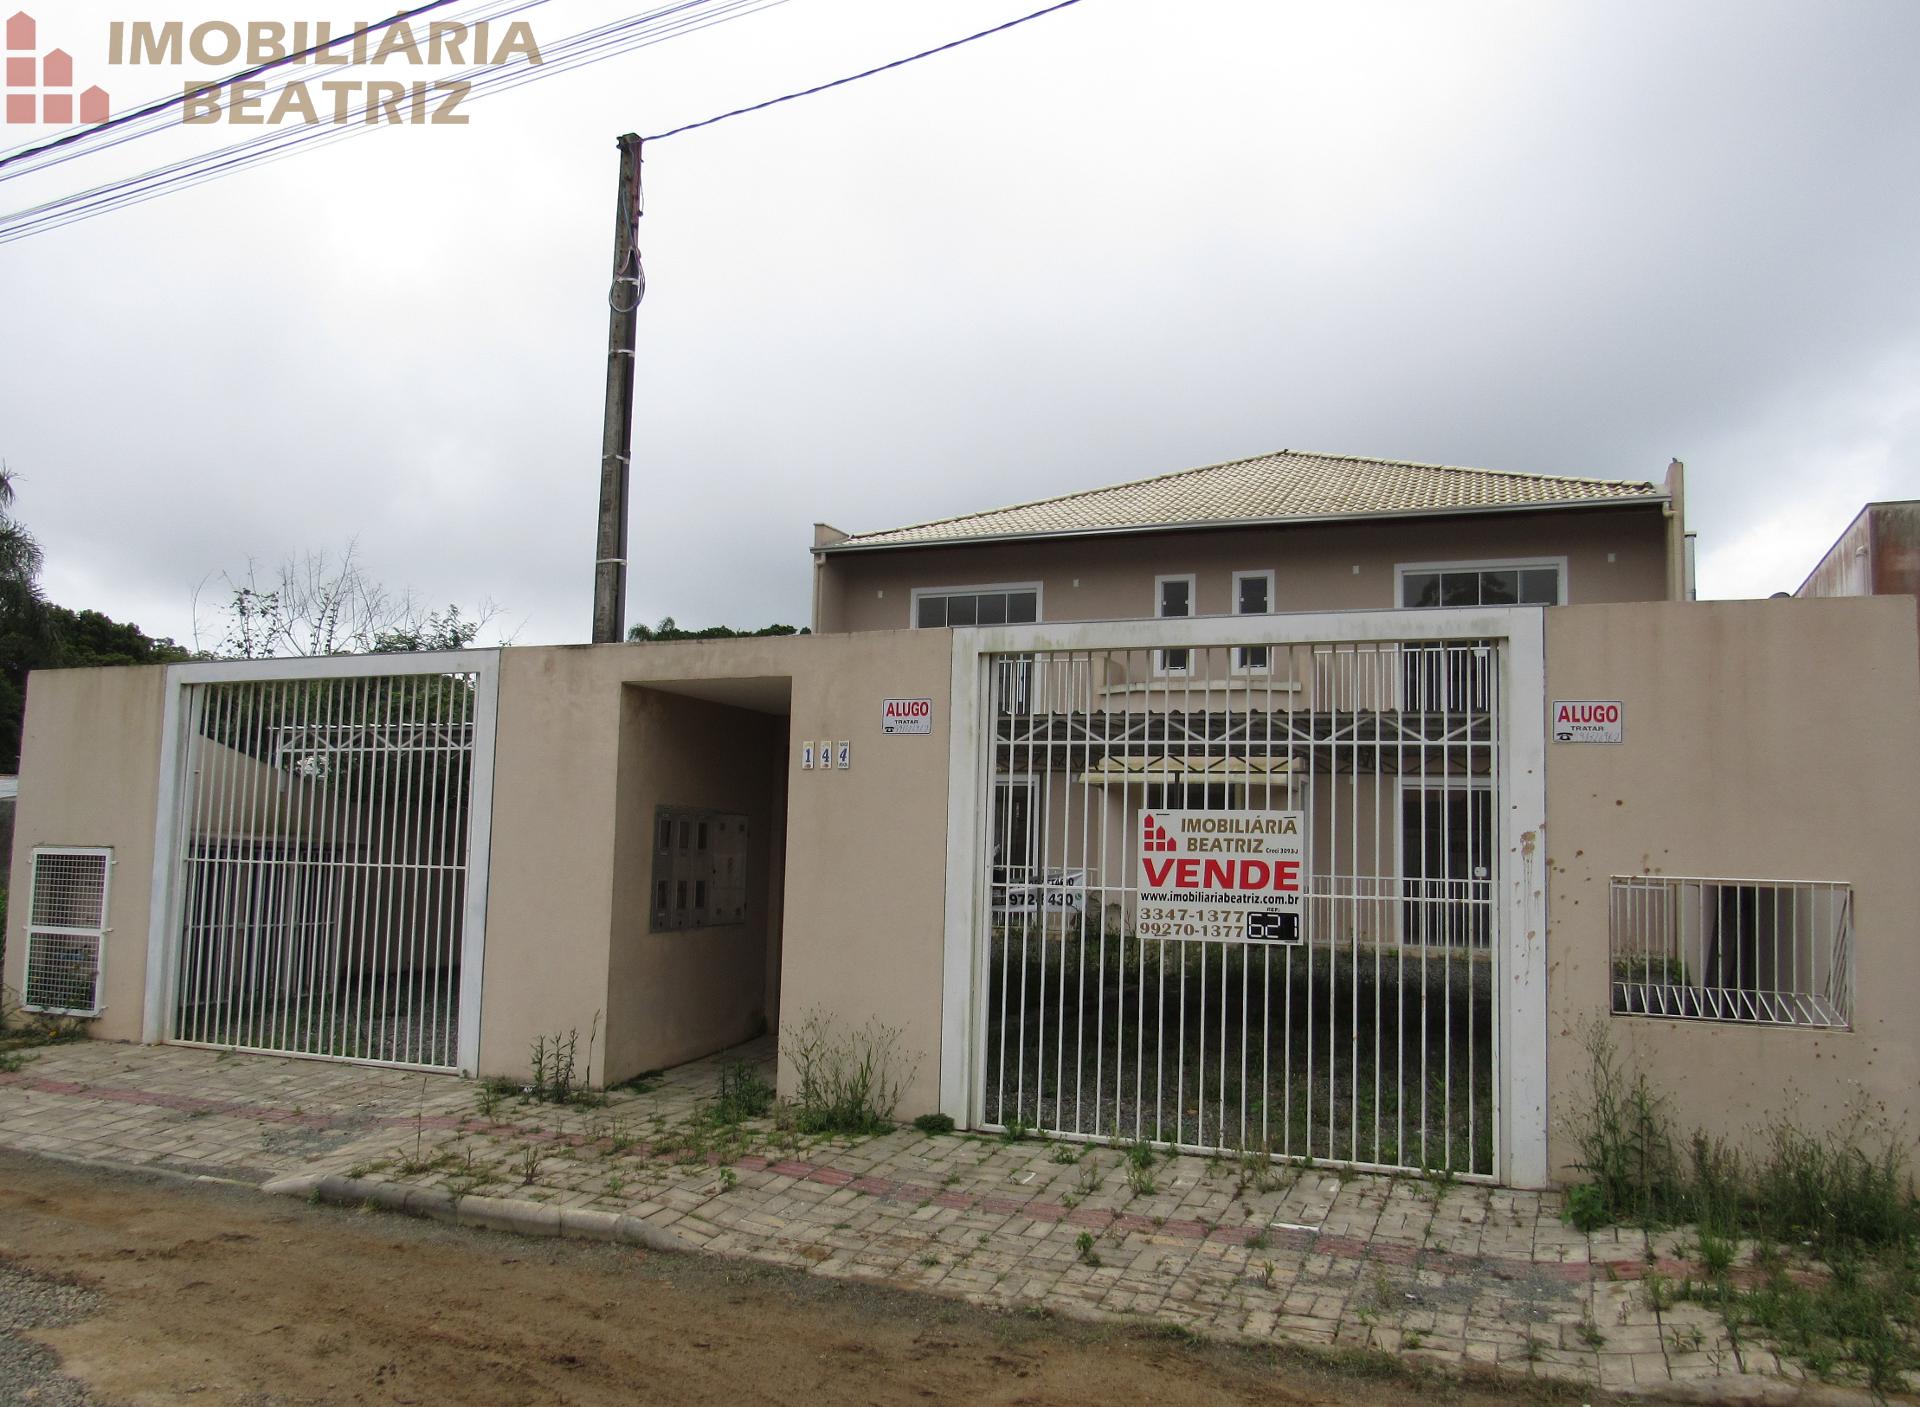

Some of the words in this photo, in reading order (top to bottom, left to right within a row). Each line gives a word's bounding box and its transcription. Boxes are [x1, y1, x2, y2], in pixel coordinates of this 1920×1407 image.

[886, 701, 929, 717] ALUGO
[1557, 705, 1618, 723] ALUGO
[1180, 815, 1297, 835] IMOBILIÁRIA
[1187, 837, 1264, 854] BEATRIZ
[1142, 857, 1300, 892] VENDE
[1141, 891, 1299, 905] www.imobiliariabeatriz.com.br
[1140, 907, 1244, 923] 3347-1377
[1140, 922, 1244, 938] 99270-1377
[1248, 913, 1298, 938] 621
